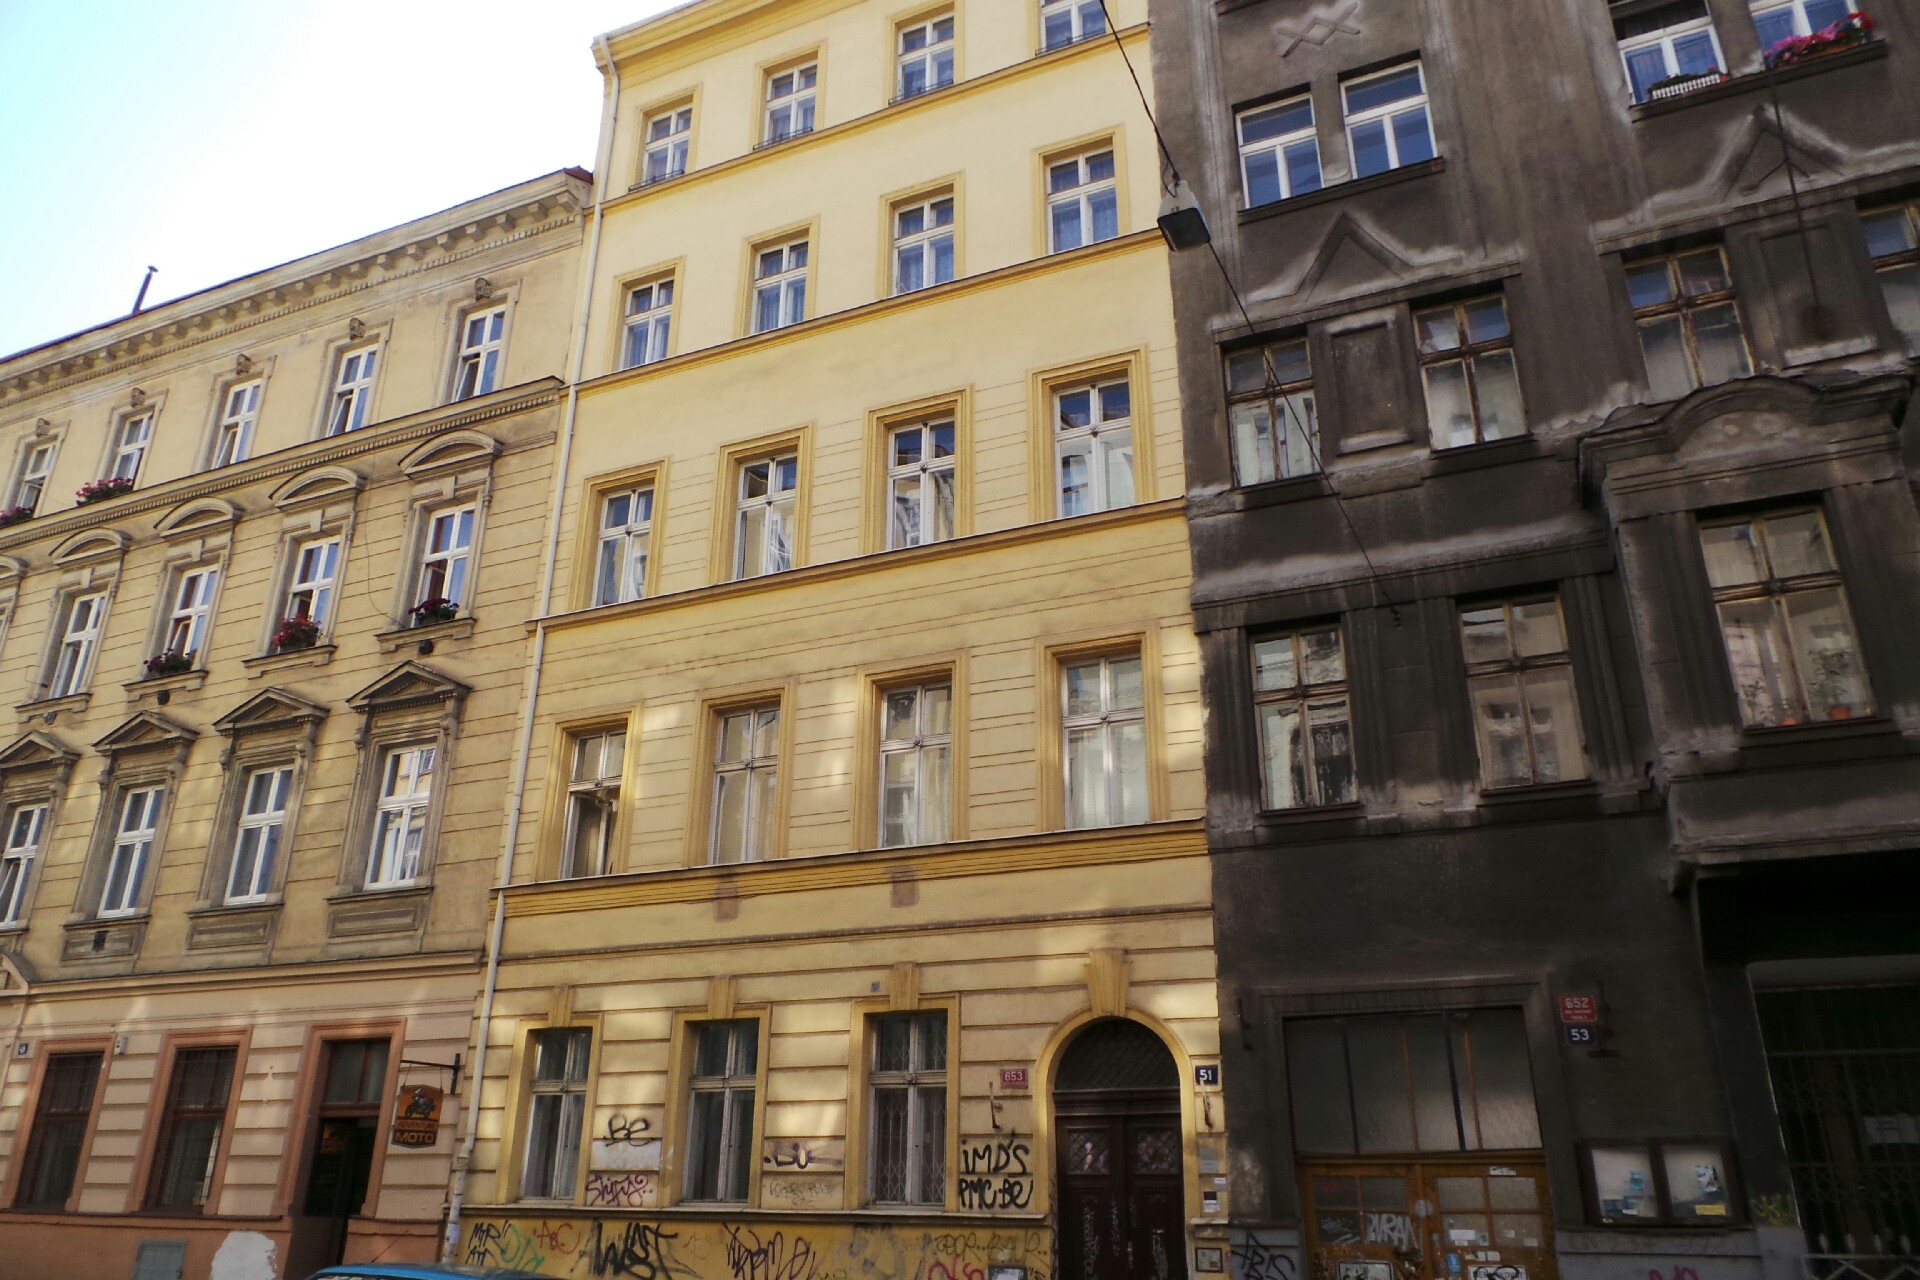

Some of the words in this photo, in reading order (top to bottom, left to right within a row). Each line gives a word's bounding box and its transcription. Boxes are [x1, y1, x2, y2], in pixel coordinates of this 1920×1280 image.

[1565, 998, 1589, 1009] 652
[1571, 1029, 1590, 1041] 53
[1004, 1071, 1024, 1082] 653
[1200, 1069, 1212, 1081] 51
[395, 1131, 434, 1144] MOTO
